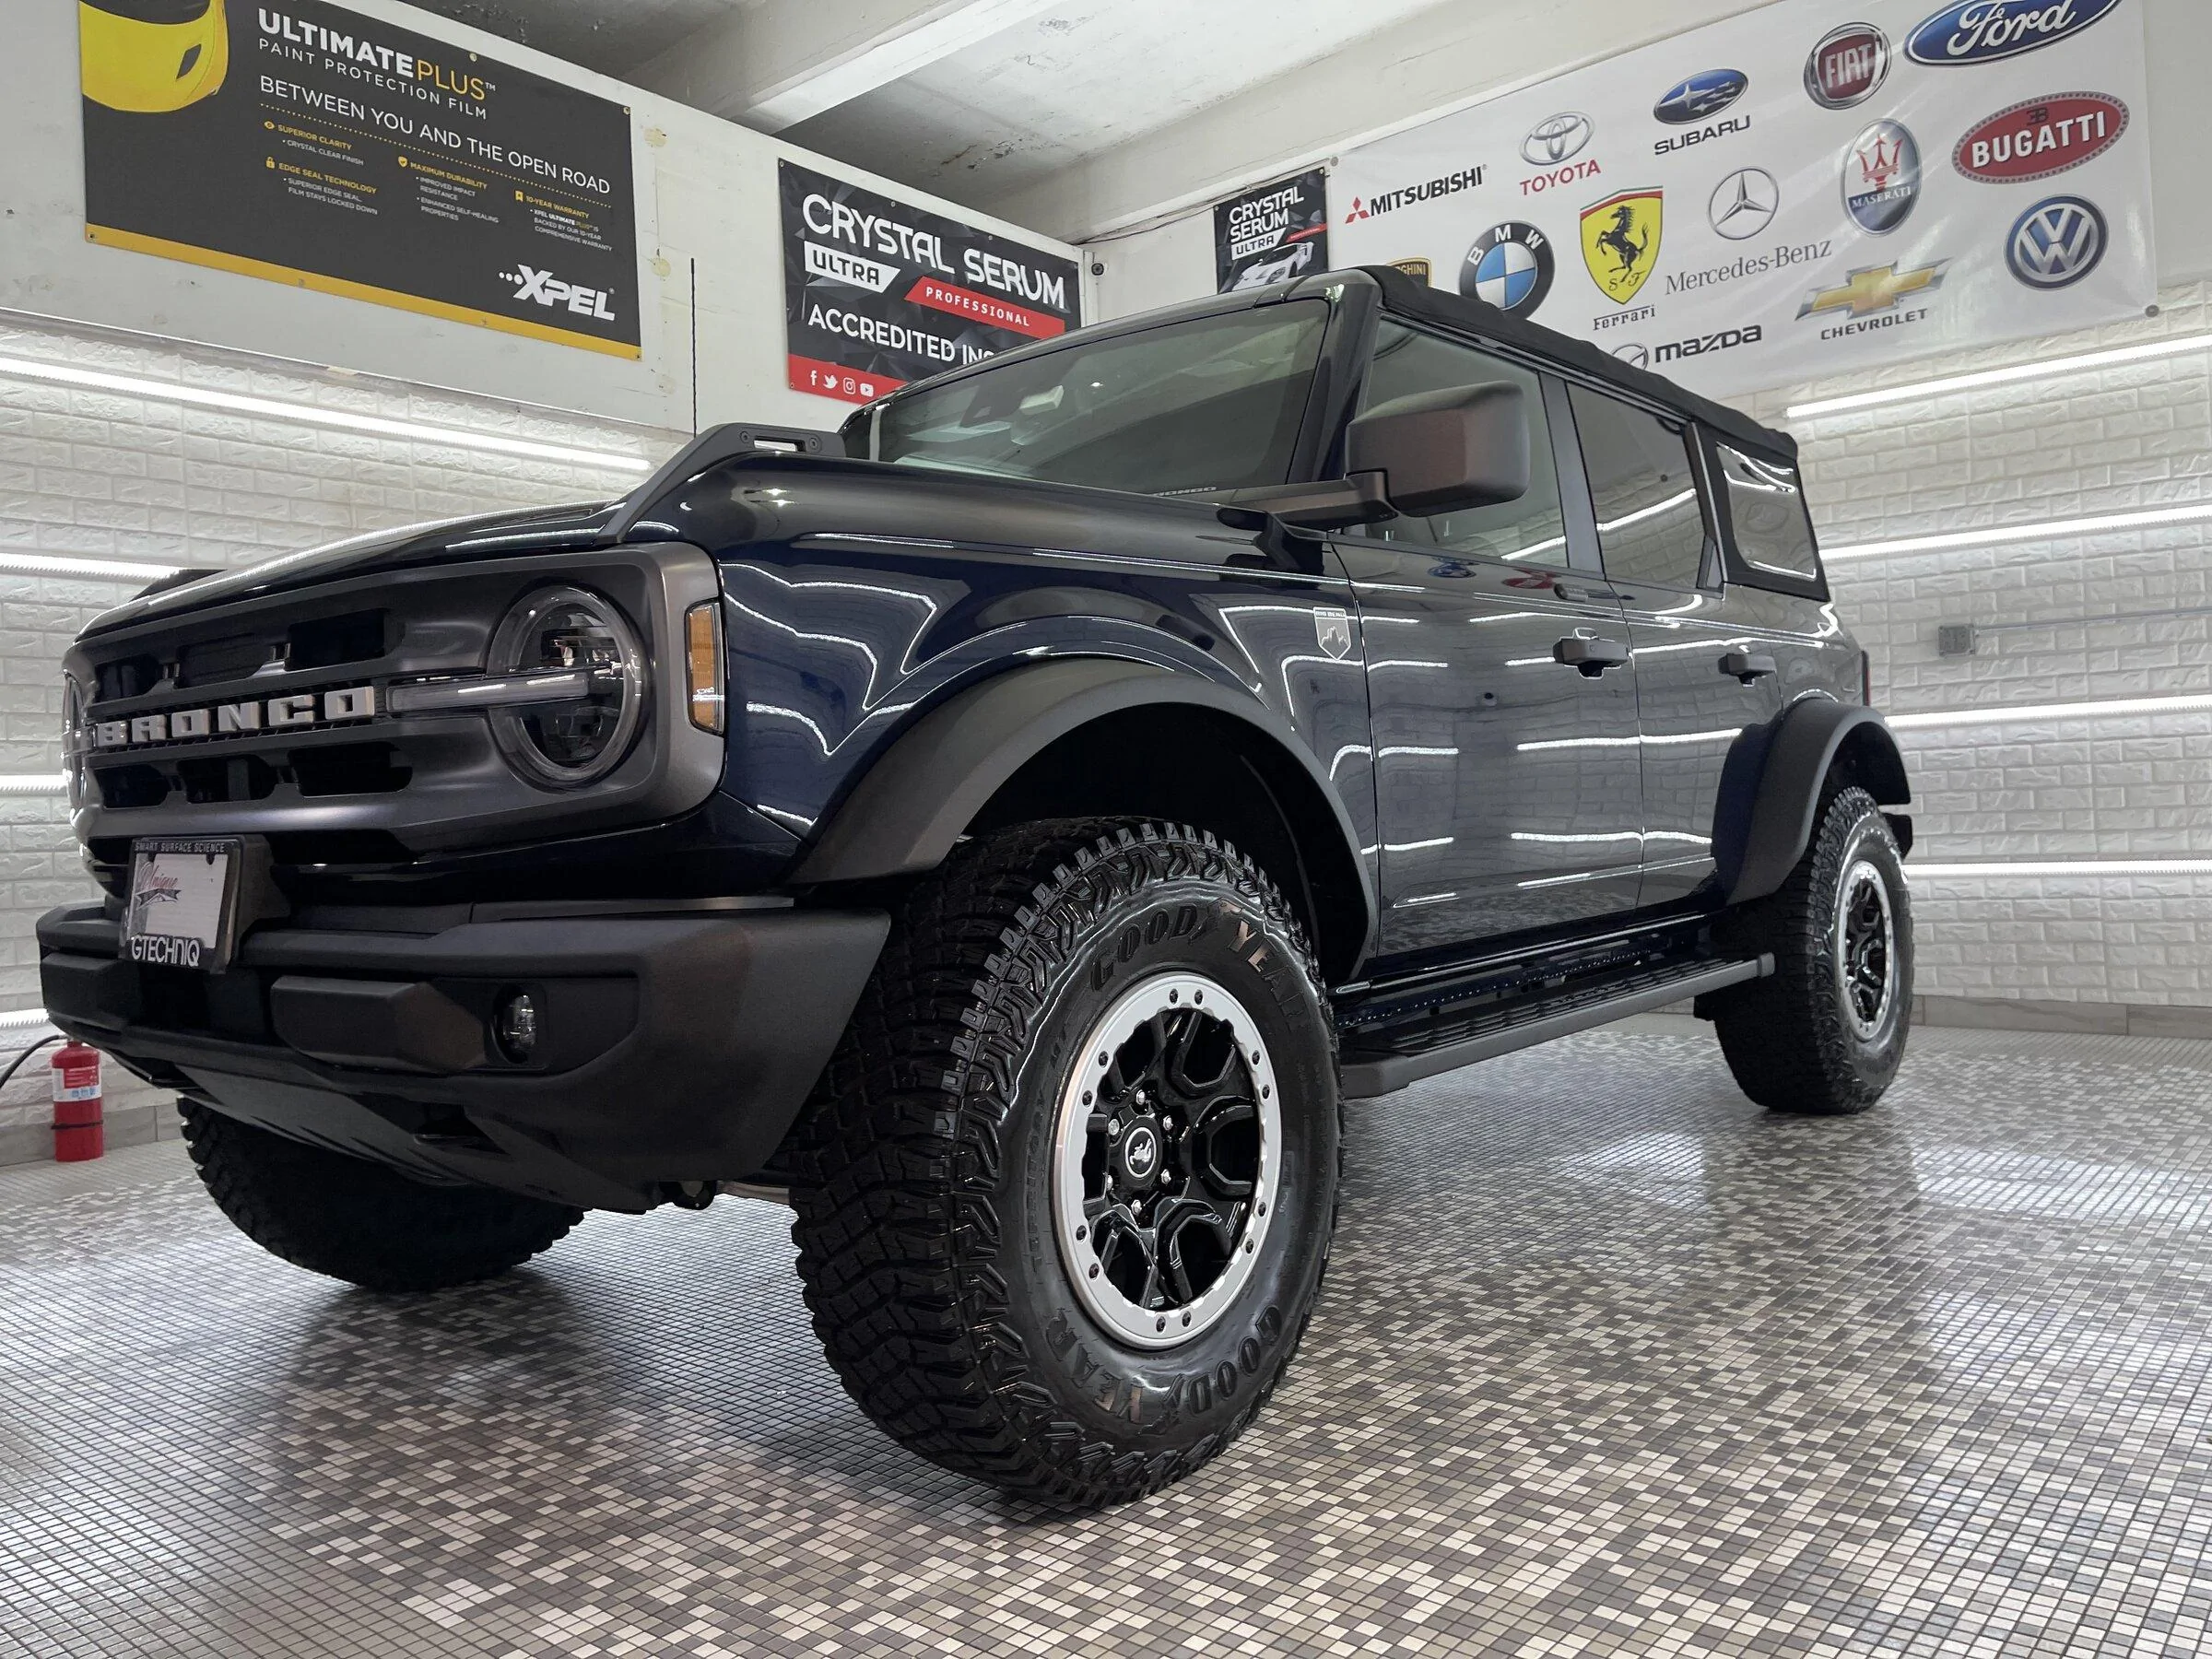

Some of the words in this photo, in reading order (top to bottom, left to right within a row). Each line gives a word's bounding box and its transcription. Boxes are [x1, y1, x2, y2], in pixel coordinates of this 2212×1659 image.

[1947, 0, 2077, 55] Ford
[259, 38, 315, 65] PAINT
[324, 58, 440, 105] PROTECTION
[449, 98, 487, 120] FILM
[1825, 43, 1872, 88] FIAT
[260, 75, 365, 121] BETWEEN
[371, 108, 413, 135] YOU
[419, 124, 462, 148] AND
[466, 137, 503, 162] THE
[508, 150, 557, 179] OPEN
[561, 167, 611, 194] ROAD
[277, 124, 318, 141] SUPERIOR
[318, 135, 352, 151] CLARITY
[287, 139, 317, 153] CRYSTAL
[318, 147, 341, 159] CLEAR
[341, 154, 364, 166] FINISH
[1654, 115, 1751, 155] SUBARU
[1971, 111, 2105, 168] BUGATTI
[278, 162, 300, 174] EDGE
[302, 168, 324, 181] SEAL
[324, 174, 378, 194] TECHNOLOGY
[288, 177, 323, 192] SUPERIOR
[323, 185, 342, 197] EDGE
[410, 161, 445, 178] MAXIMUM
[446, 172, 488, 190] DURABILITY
[1371, 166, 1482, 217] MITSUBISHI
[1519, 159, 1602, 195] TOYOTA
[288, 186, 305, 196] FILM
[305, 191, 326, 202] STAYS
[327, 196, 355, 209] LOCKED
[356, 204, 378, 215] DOWN
[525, 195, 552, 208] 10-YEAR
[553, 203, 590, 218] WARRANTY
[1229, 186, 1305, 225] CRYSTAL
[1852, 186, 1912, 208] MASERATI
[1230, 208, 1288, 243] SERUM
[802, 194, 955, 274] CRYSTAL
[963, 248, 1065, 310] SERUM
[1236, 235, 1274, 255] ULTRA
[812, 249, 879, 286] ULTRA
[1665, 239, 1832, 296] Mercedes-Benz
[925, 286, 1030, 327] PROFESSIONAL
[1593, 305, 1656, 331] Ferrari
[1820, 308, 1928, 340] CHEVROLET
[807, 303, 956, 362] ACCREDITED
[93, 686, 375, 747] BRONCO
[135, 841, 158, 852] SMART
[160, 842, 193, 853] SURFACE
[194, 842, 225, 853] SCIENCE
[131, 935, 201, 967] GTECHNIQ
